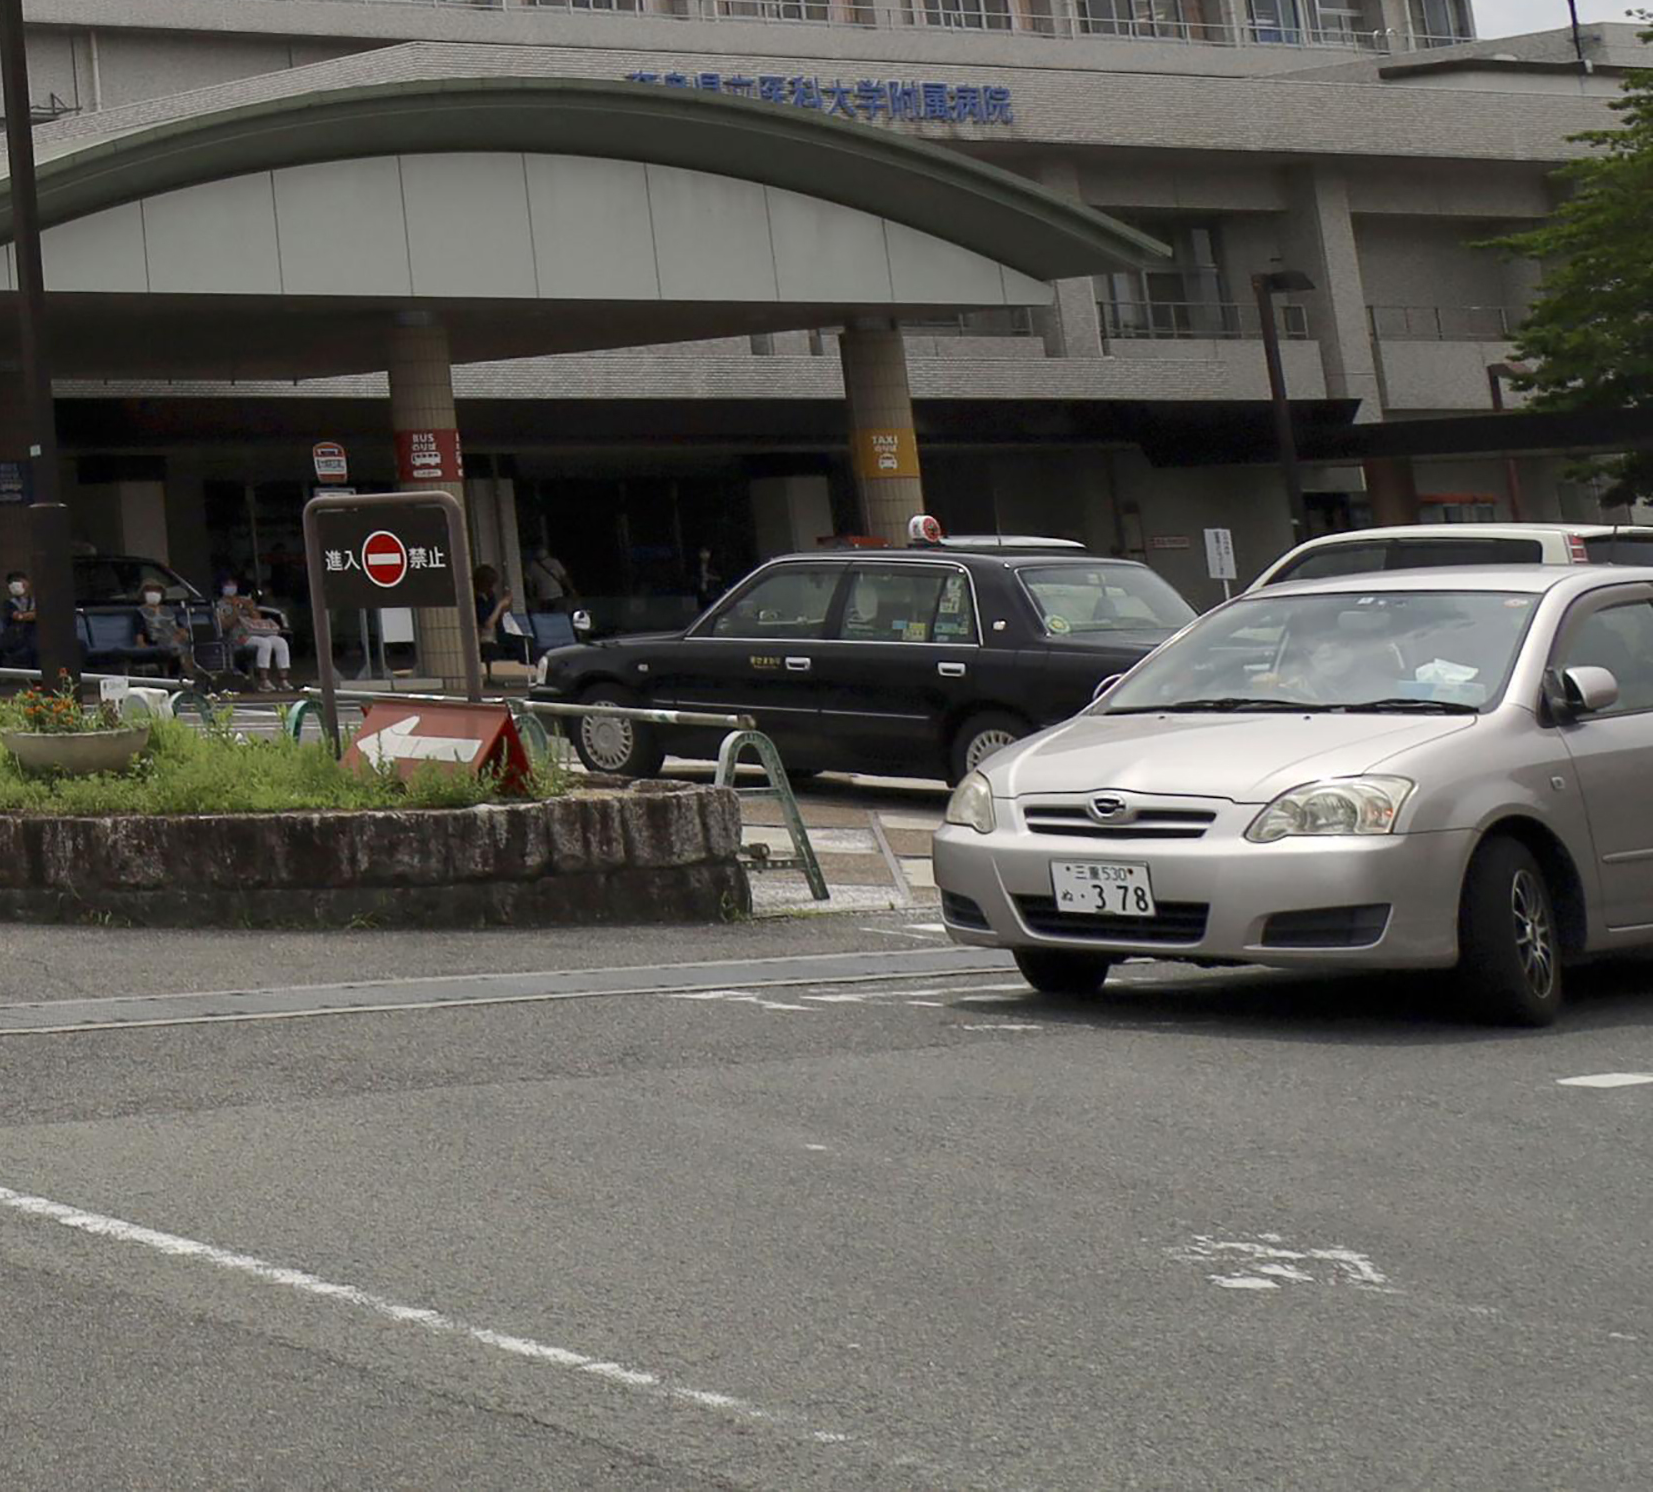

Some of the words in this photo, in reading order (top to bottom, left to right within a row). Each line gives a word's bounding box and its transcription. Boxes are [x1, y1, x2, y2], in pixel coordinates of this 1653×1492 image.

[412, 433, 435, 443] BUS
[872, 435, 898, 444] TAXI
[325, 550, 361, 570] 進入
[408, 546, 446, 569] 禁止
